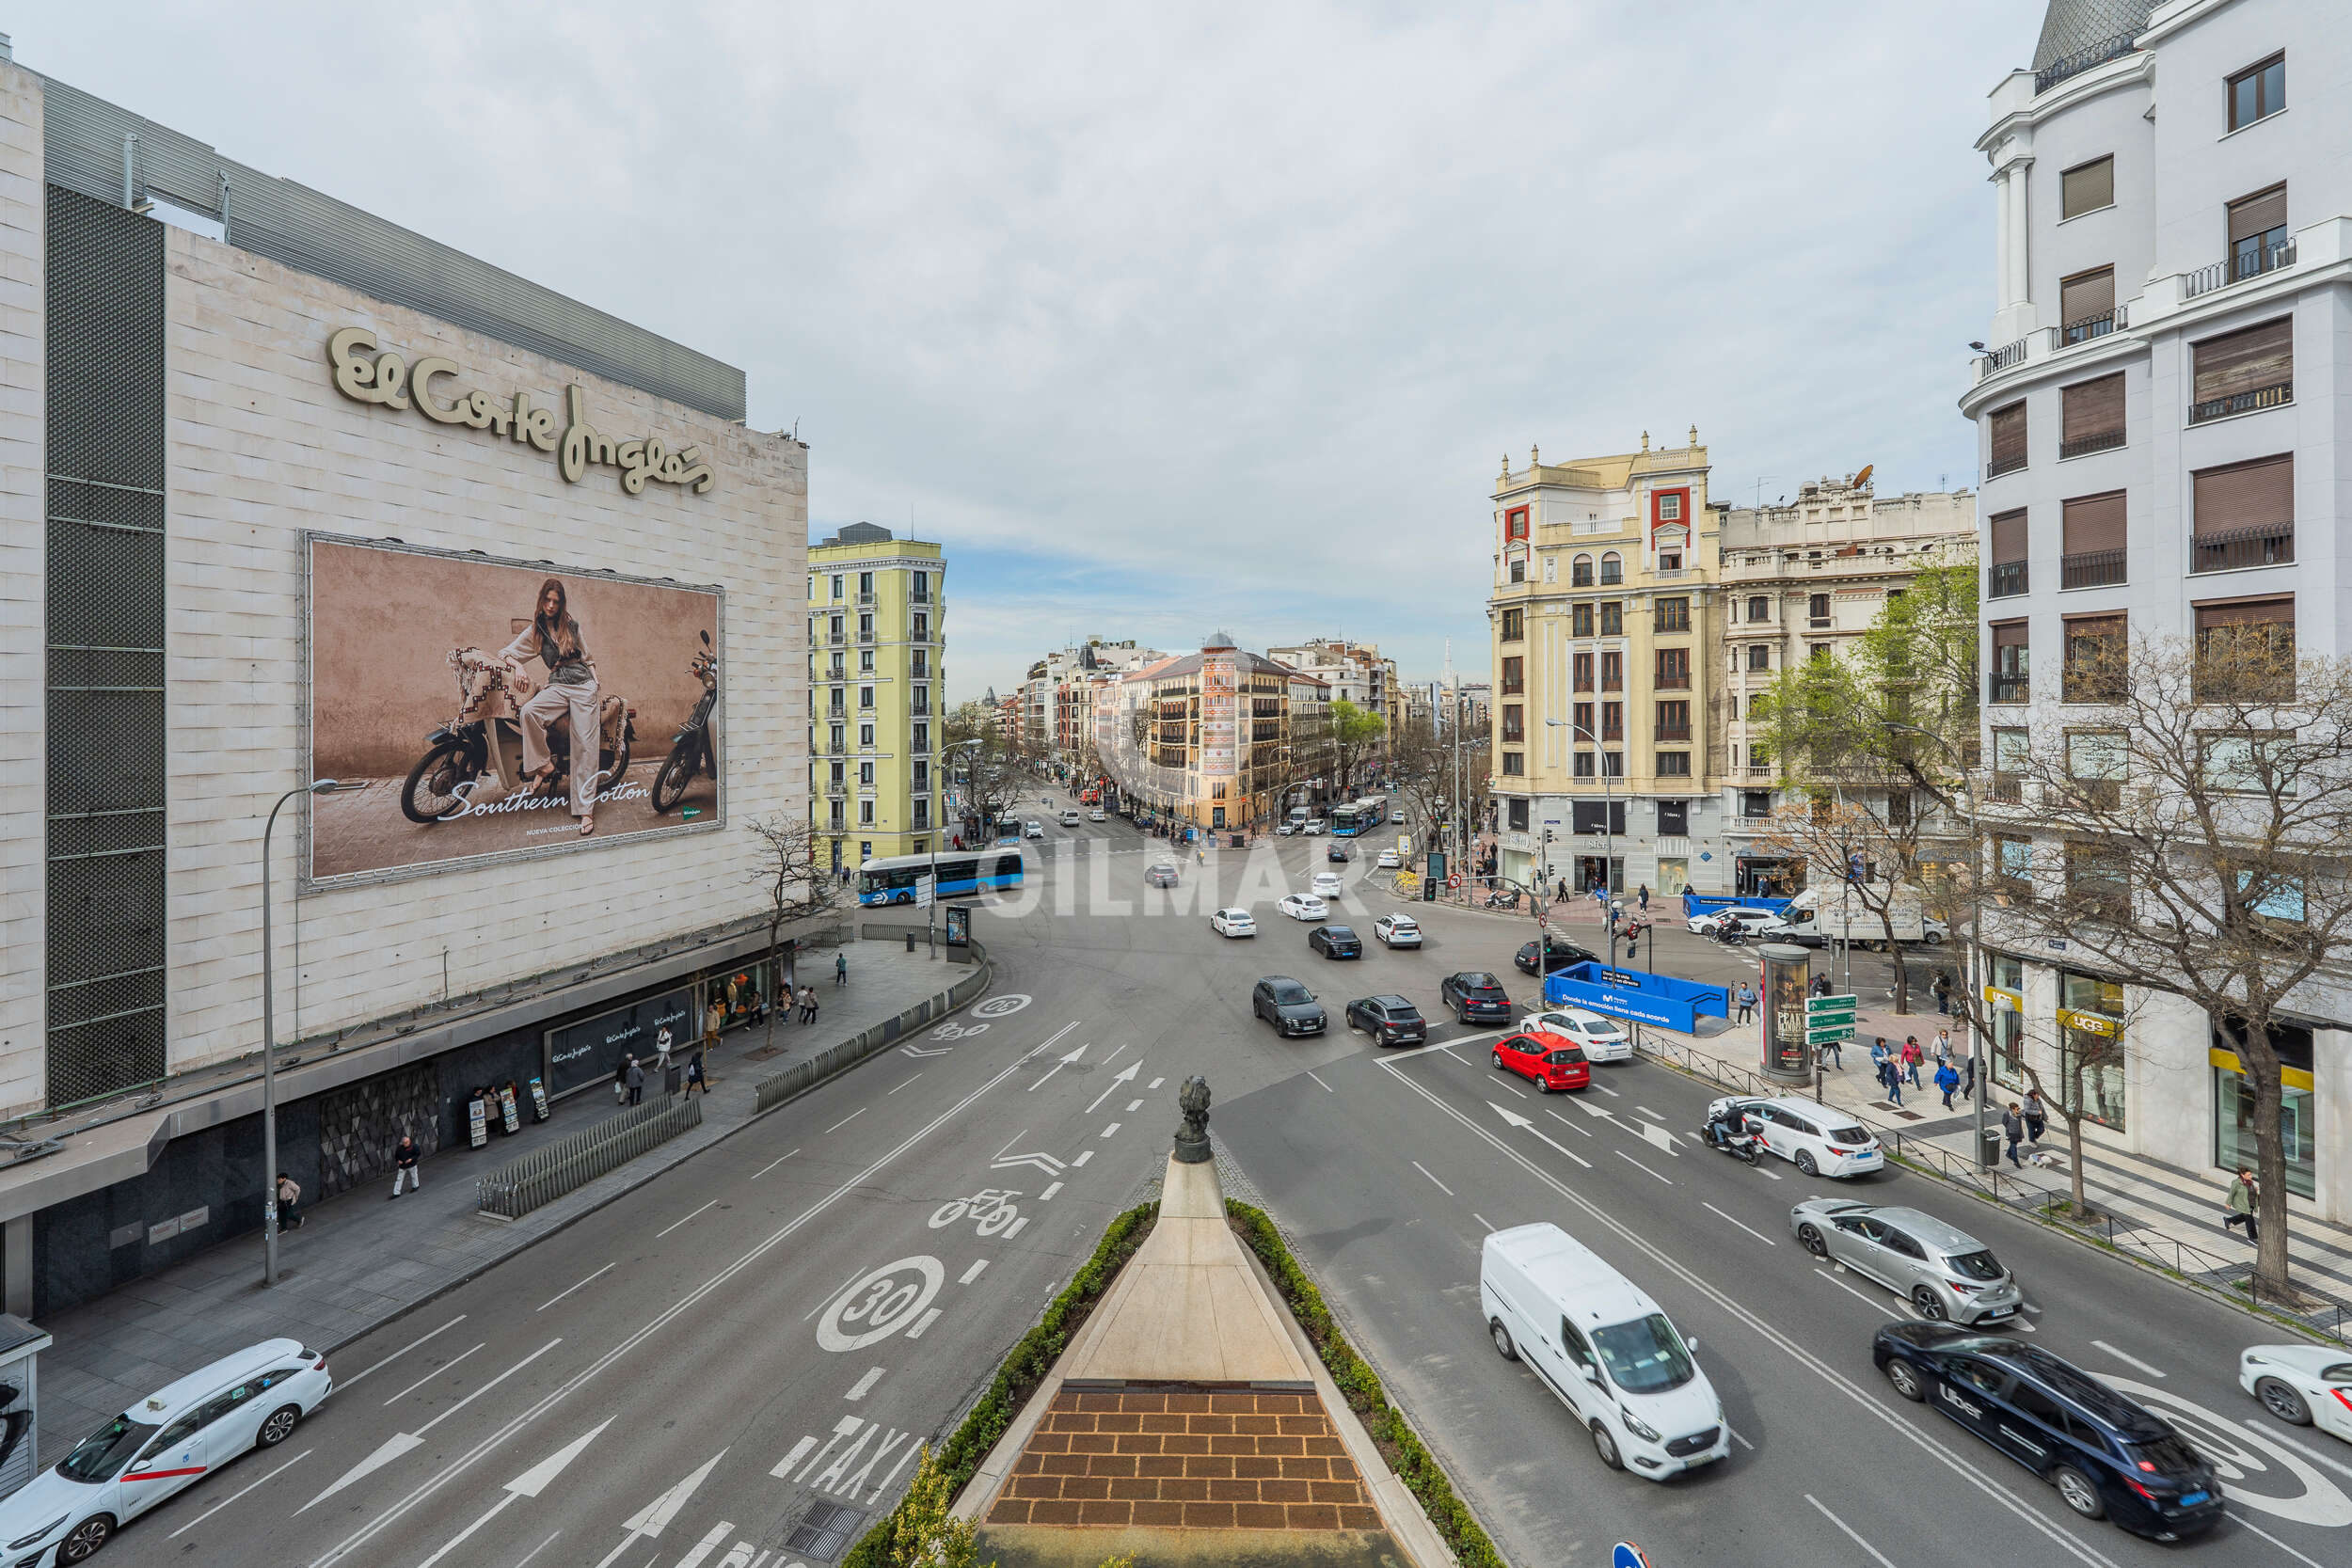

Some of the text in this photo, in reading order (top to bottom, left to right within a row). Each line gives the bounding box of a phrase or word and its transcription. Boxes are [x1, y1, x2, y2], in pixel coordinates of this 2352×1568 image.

[327, 326, 715, 495] El Corte Inglés
[437, 769, 651, 821] Southern Cotton
[526, 828, 548, 836] NUEVA
[2074, 1015, 2104, 1032] UGG
[843, 1278, 920, 1327] 30
[1939, 1382, 1983, 1420] Uber
[792, 1414, 927, 1506] TAXI
